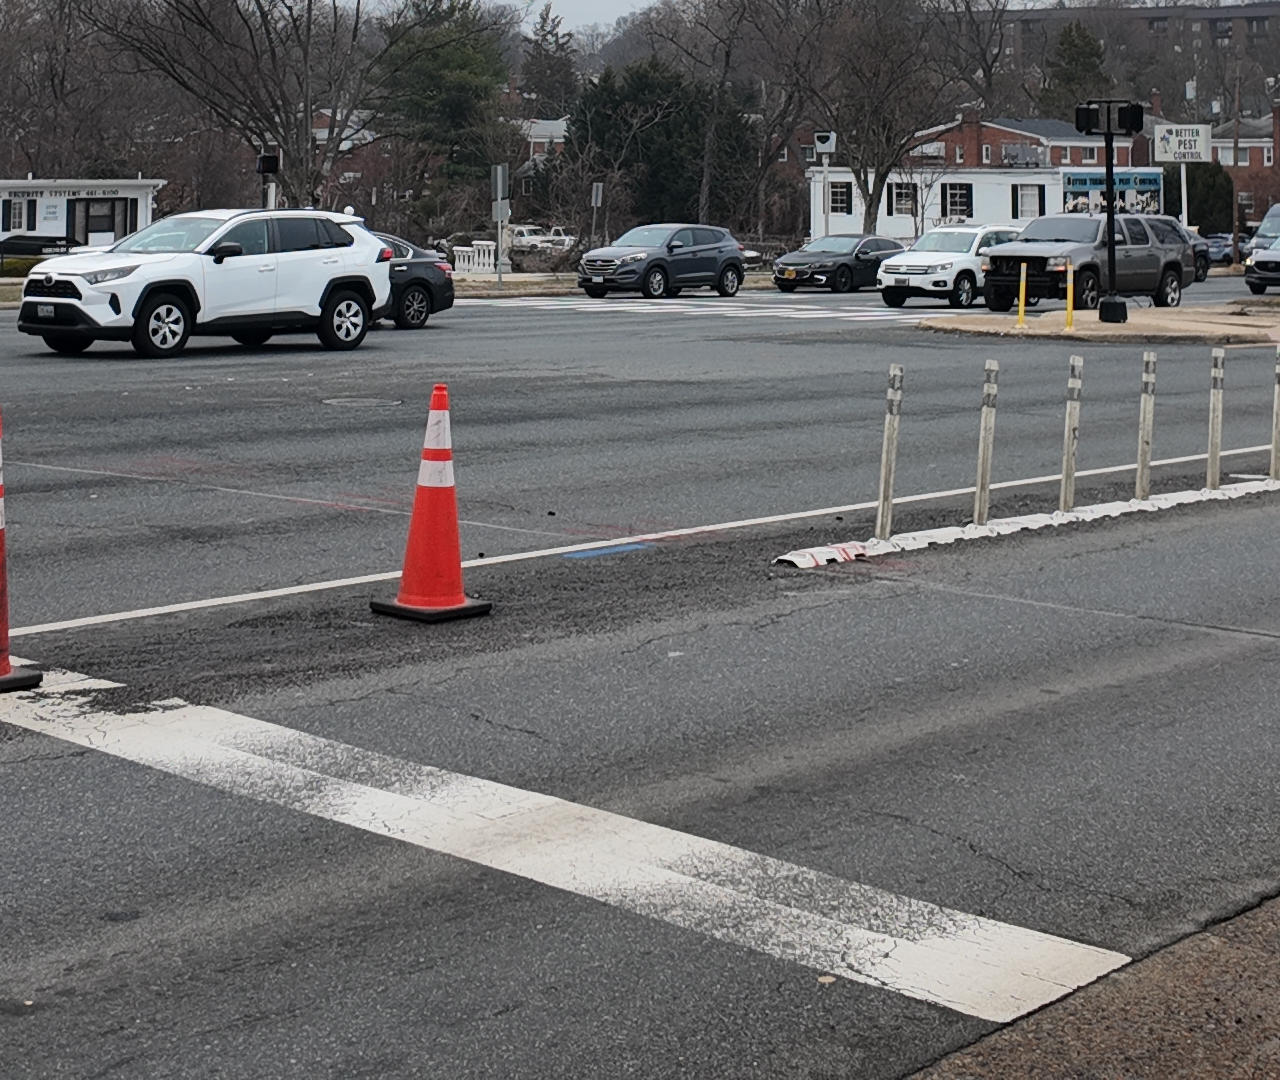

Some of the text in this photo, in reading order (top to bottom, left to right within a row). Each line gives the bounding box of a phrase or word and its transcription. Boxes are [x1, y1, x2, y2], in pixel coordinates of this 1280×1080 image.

[1175, 128, 1200, 138] BETTER
[1177, 139, 1198, 150] PEST
[1173, 151, 1202, 160] CONTROL
